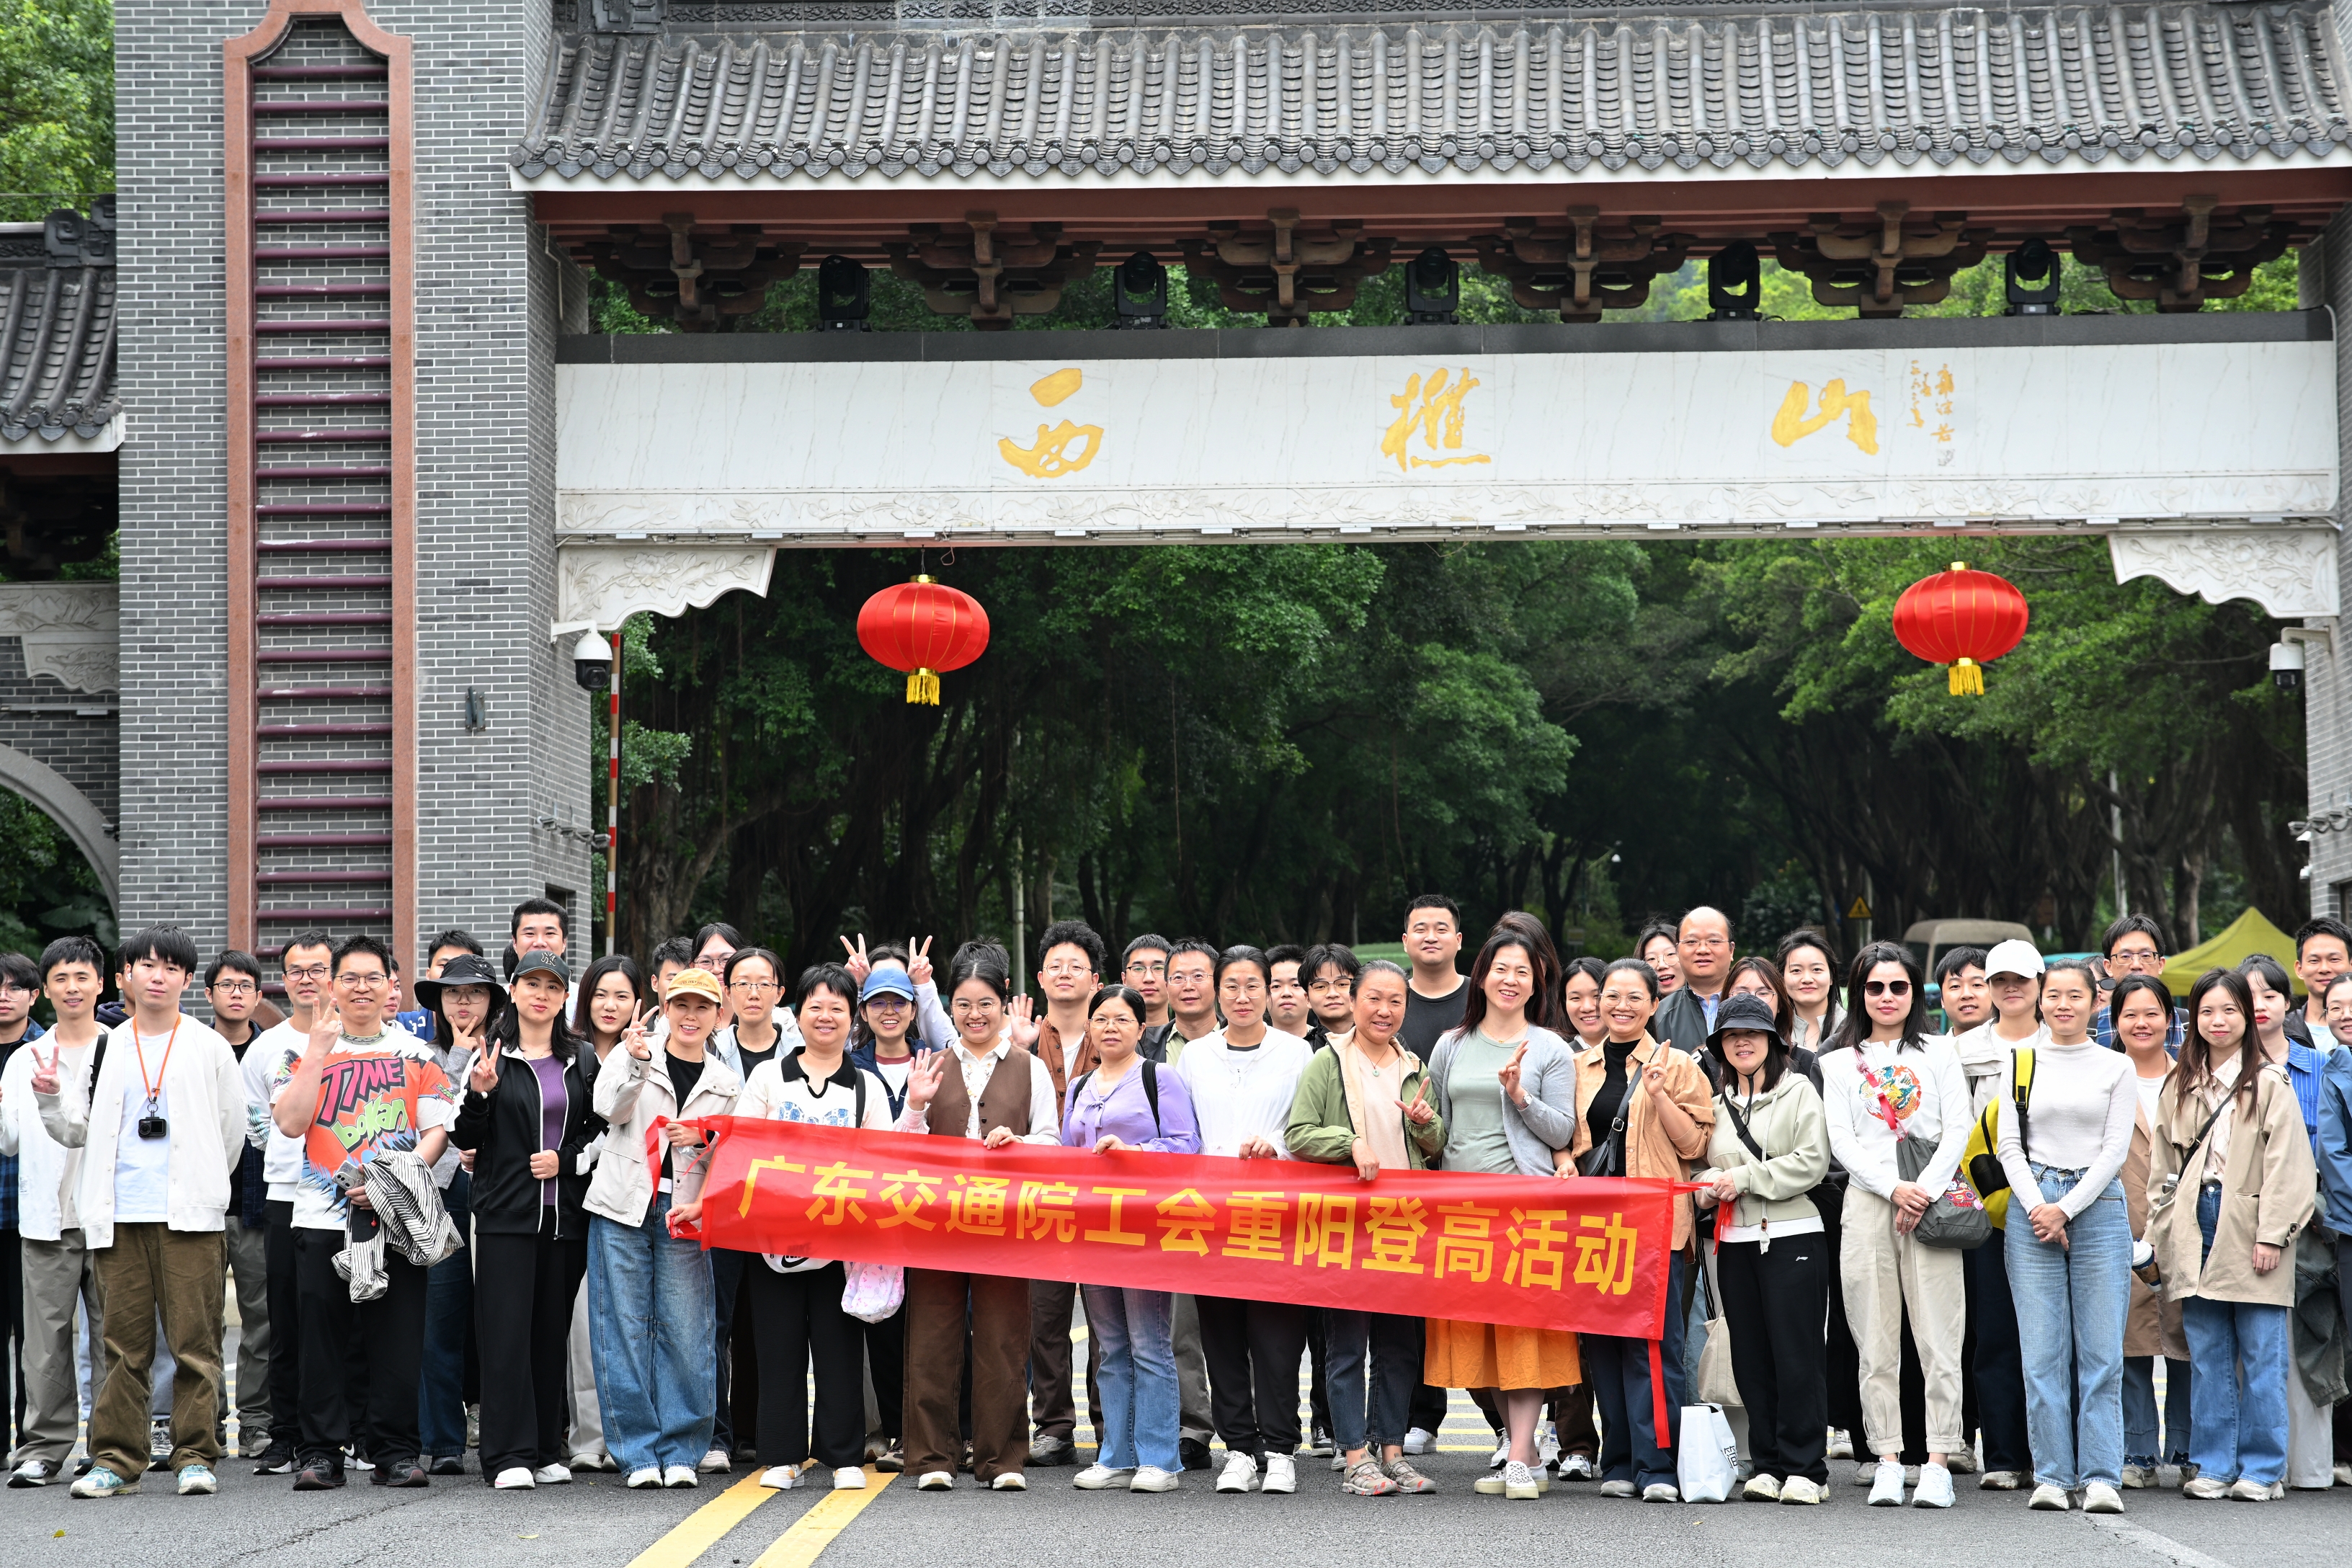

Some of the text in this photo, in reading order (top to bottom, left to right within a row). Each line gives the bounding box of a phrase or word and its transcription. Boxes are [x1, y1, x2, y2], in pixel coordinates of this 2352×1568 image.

[317, 1057, 406, 1126] TIME
[739, 1155, 1638, 1296] 广东交通院工会重阳登高活动
